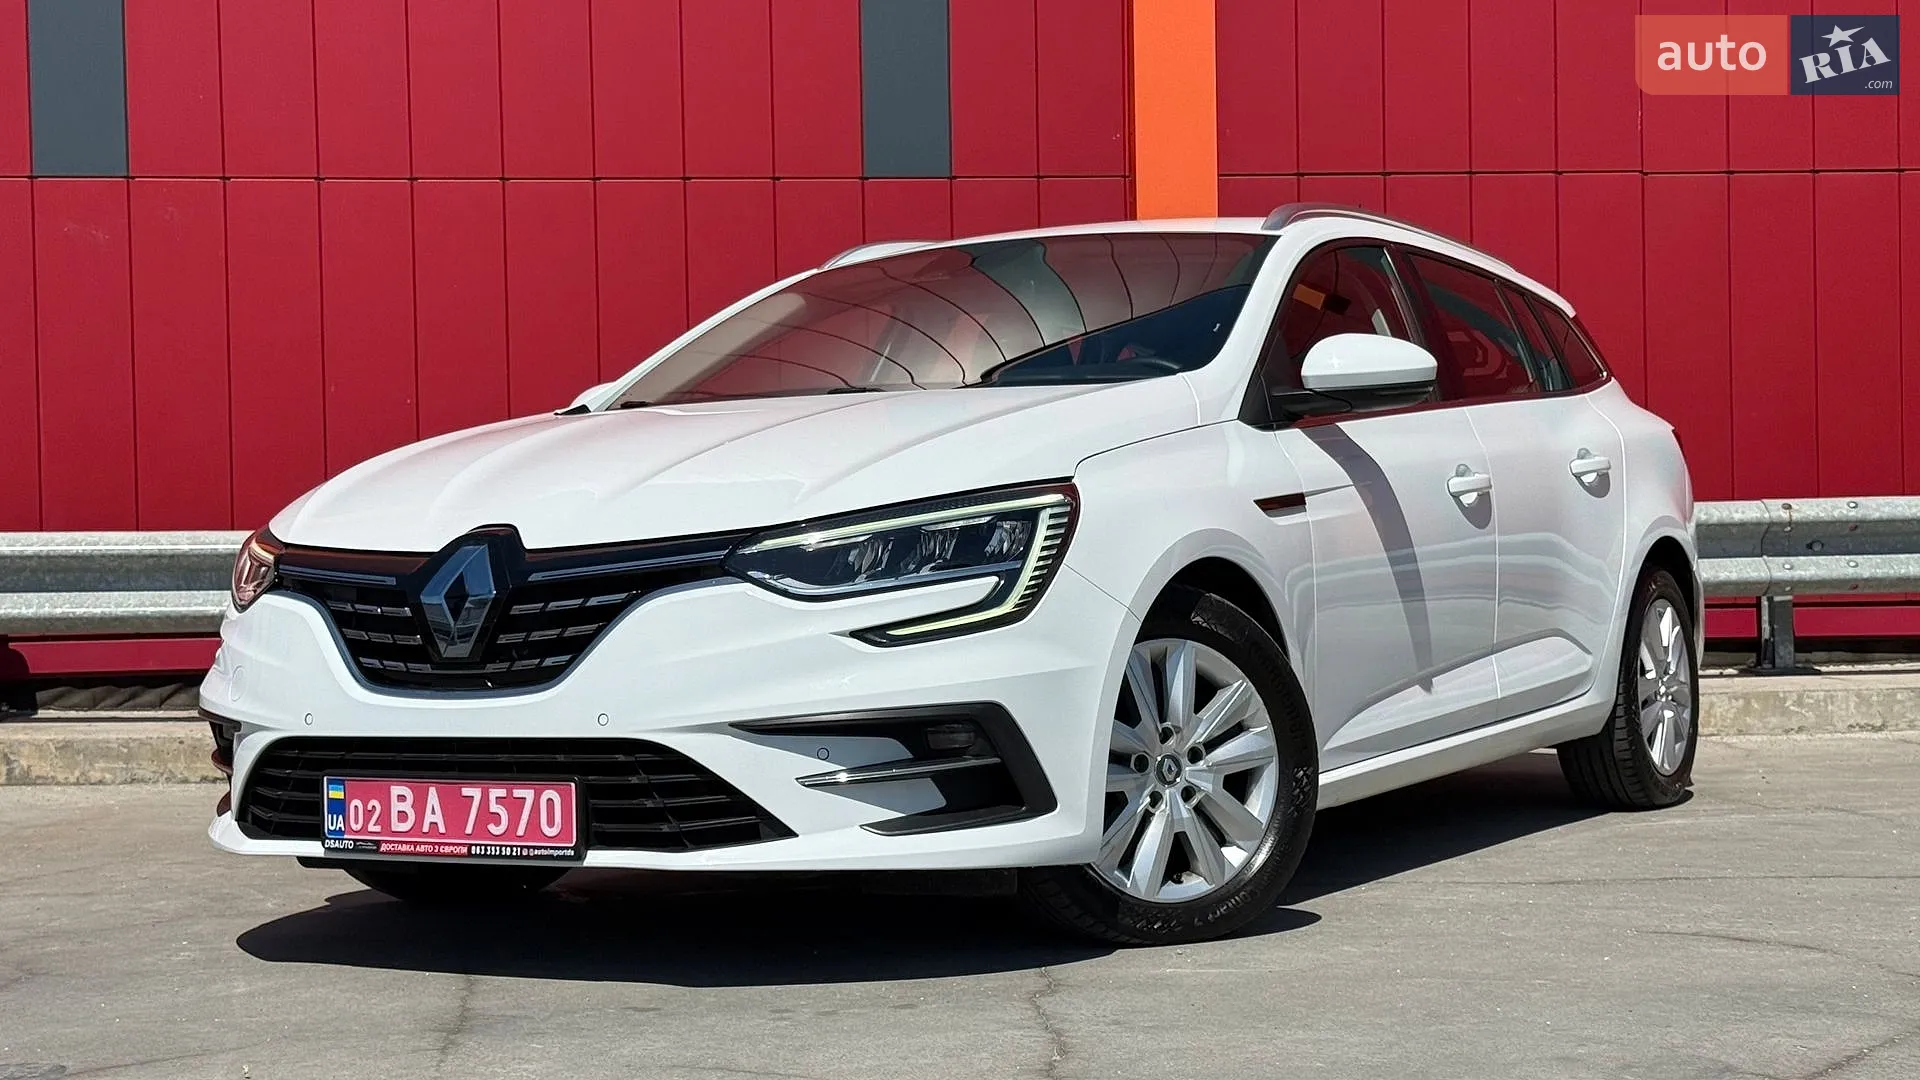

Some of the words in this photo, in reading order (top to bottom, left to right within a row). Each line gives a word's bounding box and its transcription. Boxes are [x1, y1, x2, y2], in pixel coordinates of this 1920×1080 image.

[350, 799, 382, 833] 02
[390, 785, 447, 834] BA
[461, 787, 562, 838] 7570
[328, 814, 345, 831] UA
[324, 840, 354, 850] DSAUTO
[380, 843, 415, 852] ДОСТАВКА
[416, 844, 434, 853] АВТО
[512, 846, 521, 856] 21
